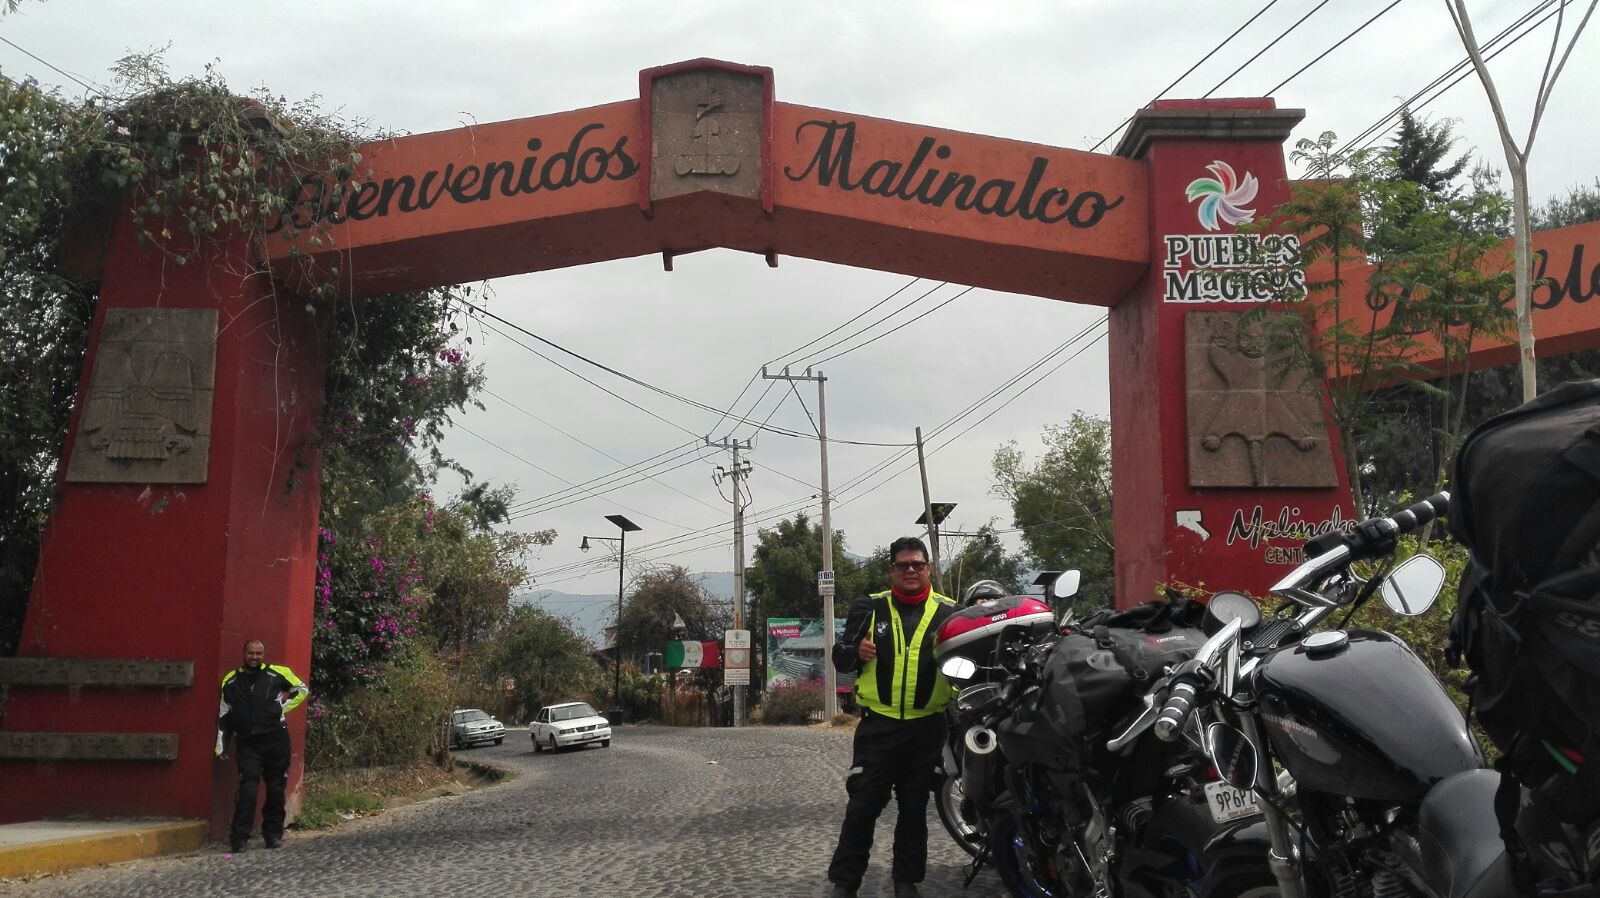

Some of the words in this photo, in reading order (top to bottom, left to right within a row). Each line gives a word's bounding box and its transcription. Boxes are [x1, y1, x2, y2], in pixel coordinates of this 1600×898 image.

[266, 123, 640, 233] Bienvenidos
[784, 119, 1125, 228] Malinalco
[1164, 234, 1302, 267] PUEBLOS
